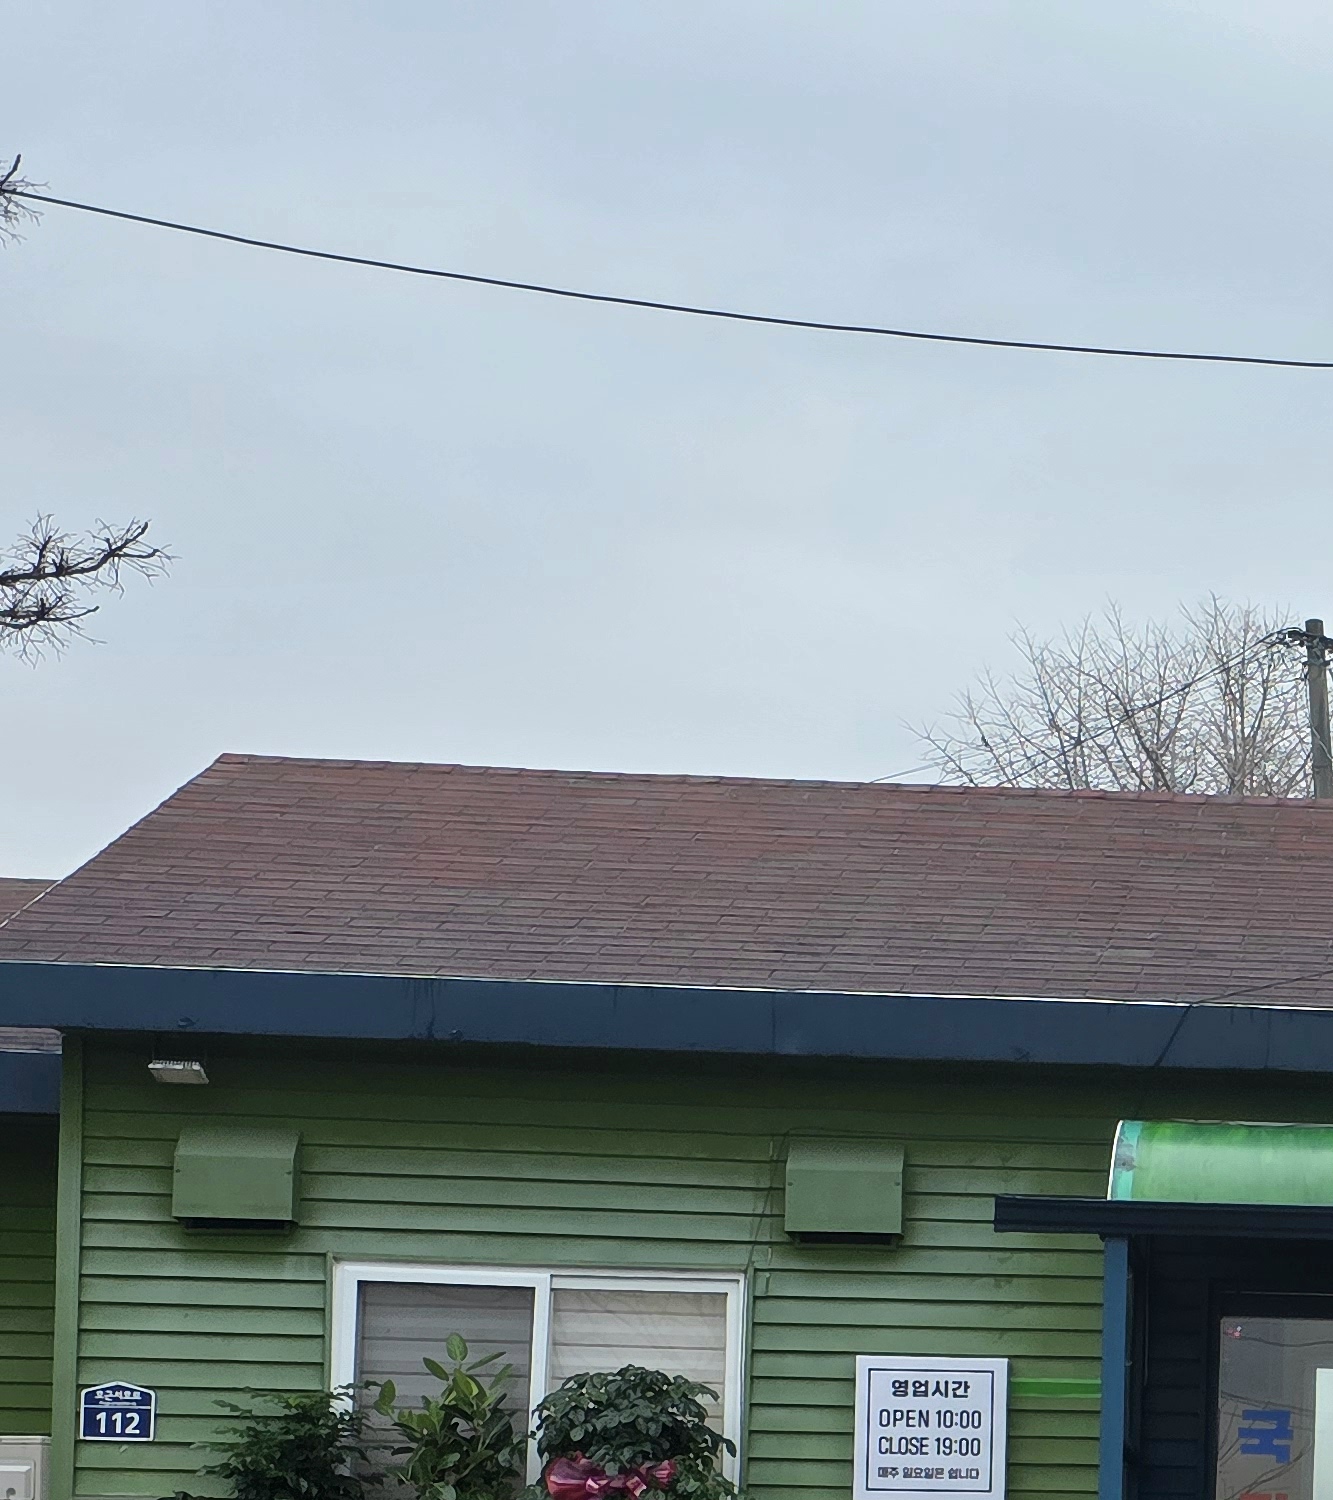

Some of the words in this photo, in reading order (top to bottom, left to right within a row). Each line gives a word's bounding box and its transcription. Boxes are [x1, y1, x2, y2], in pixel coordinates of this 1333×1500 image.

[892, 1380, 970, 1398] 영업시간
[96, 1412, 140, 1434] 112
[879, 1409, 929, 1427] OPEN
[936, 1410, 981, 1429] 10:00
[878, 1437, 929, 1455] CLOSE
[935, 1437, 980, 1456] 19:00
[878, 1467, 899, 1478] 매주
[902, 1467, 944, 1479] 일요일은
[948, 1468, 979, 1480] 쉽니다
